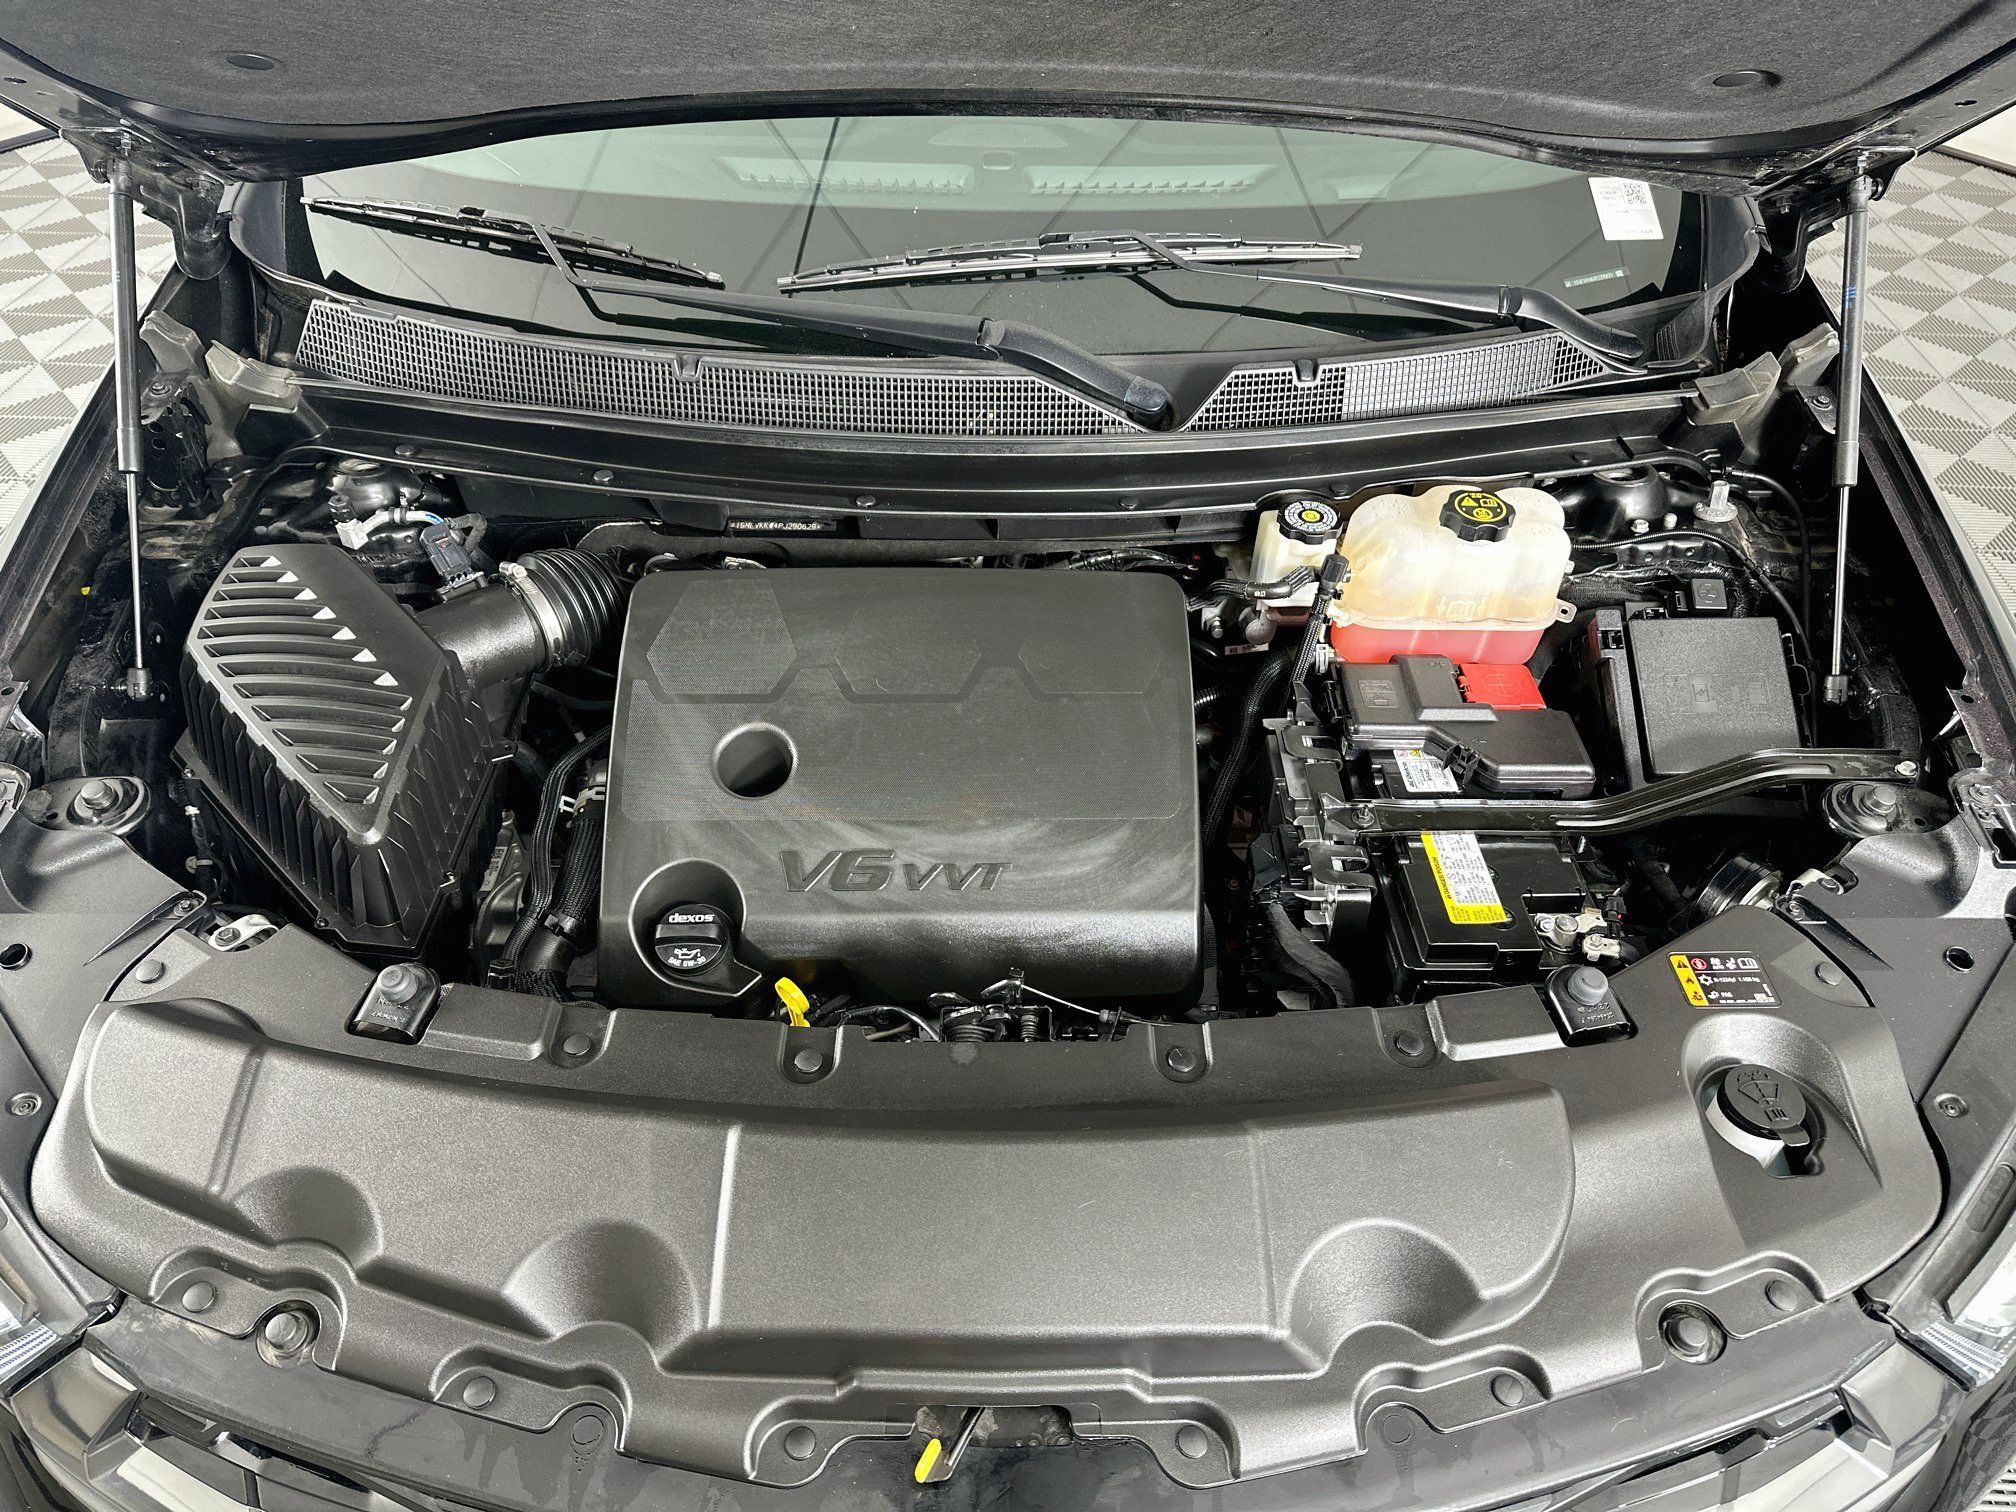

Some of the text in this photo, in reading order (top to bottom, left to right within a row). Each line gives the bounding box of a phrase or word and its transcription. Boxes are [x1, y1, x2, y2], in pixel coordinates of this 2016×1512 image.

[779, 849, 1013, 892] V6 VVT
[668, 912, 715, 923] dexos
[667, 955, 707, 968] SAE 5W-30
